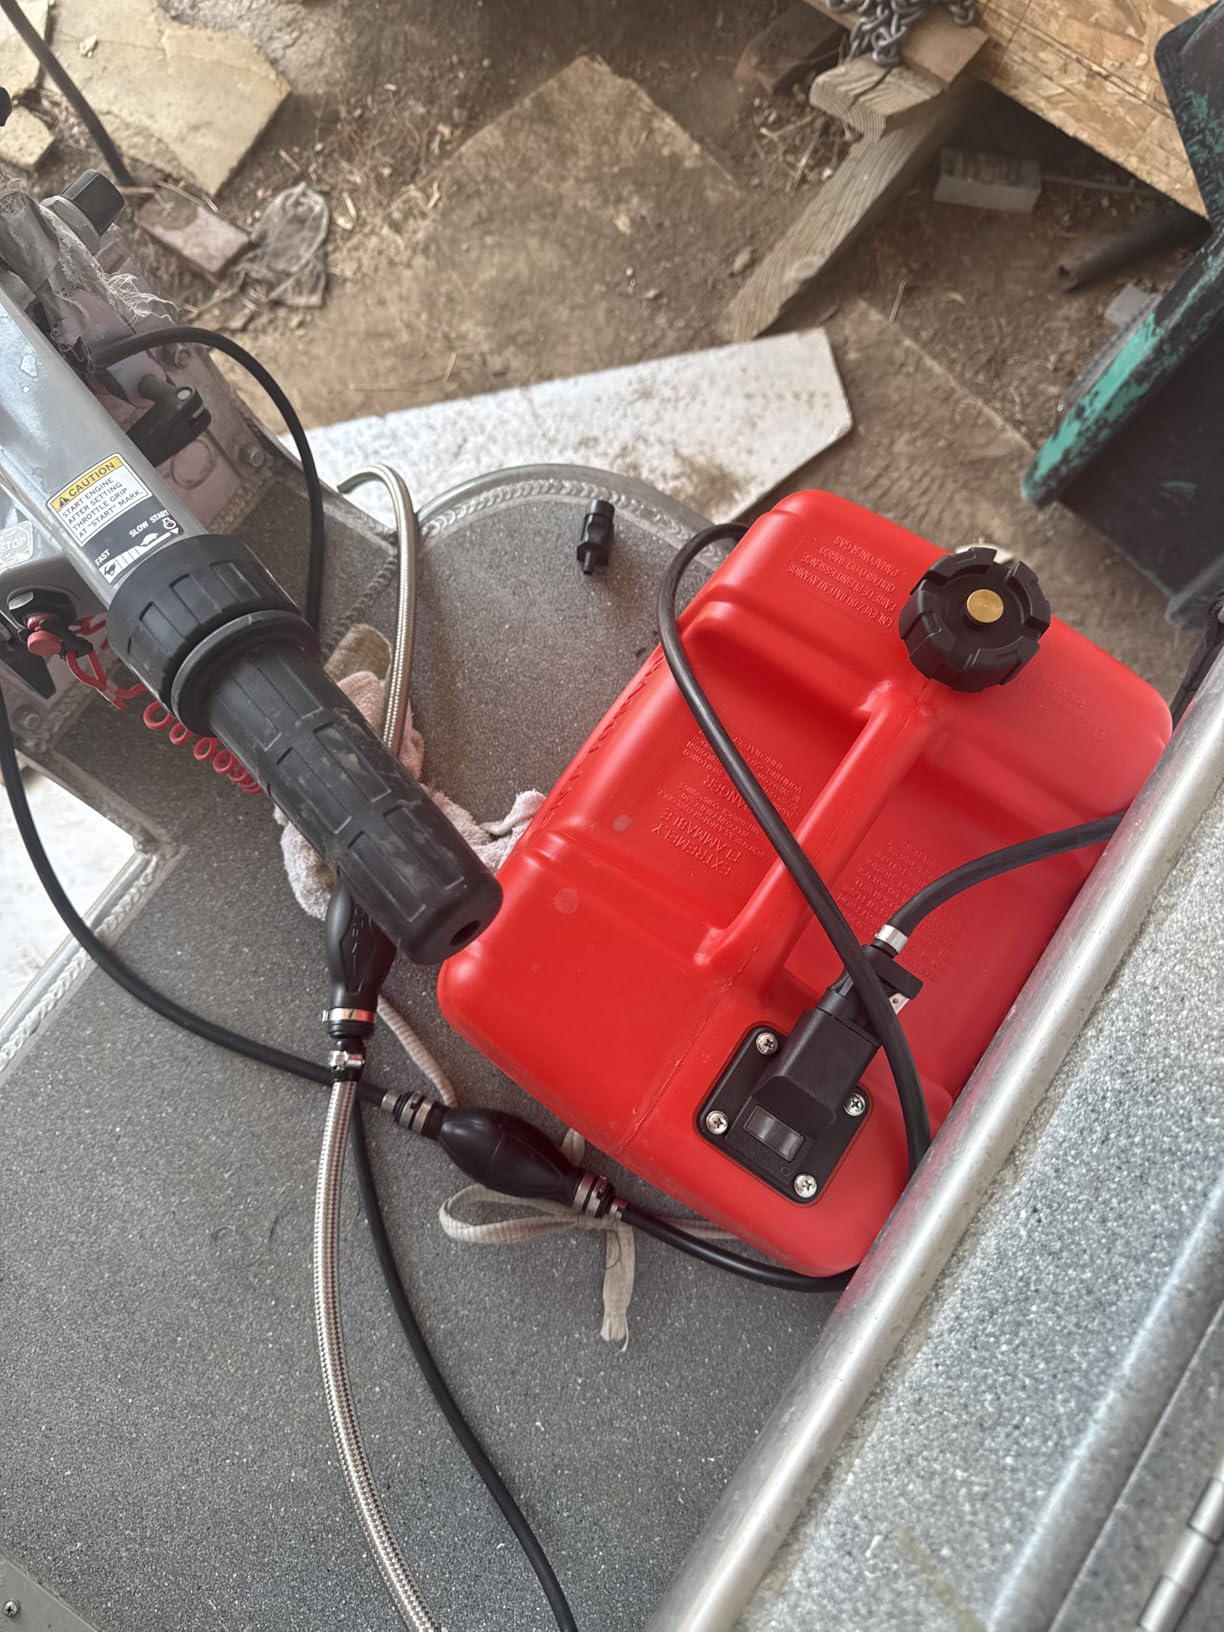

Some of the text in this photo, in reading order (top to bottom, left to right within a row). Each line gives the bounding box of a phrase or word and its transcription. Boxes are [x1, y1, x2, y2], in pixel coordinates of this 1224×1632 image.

[63, 478, 114, 518] START ENGINE
[69, 462, 115, 497] CAUTION
[68, 482, 122, 524] AFTER SETTING
[73, 488, 128, 531] THROTTLE GRIP
[79, 490, 144, 538] AT "START" MARK.
[150, 510, 169, 523] START
[129, 521, 149, 537] SLOW
[95, 549, 110, 566] FAST
[651, 821, 732, 876] EXTREMELY
[660, 807, 740, 862] FLAMMABLE
